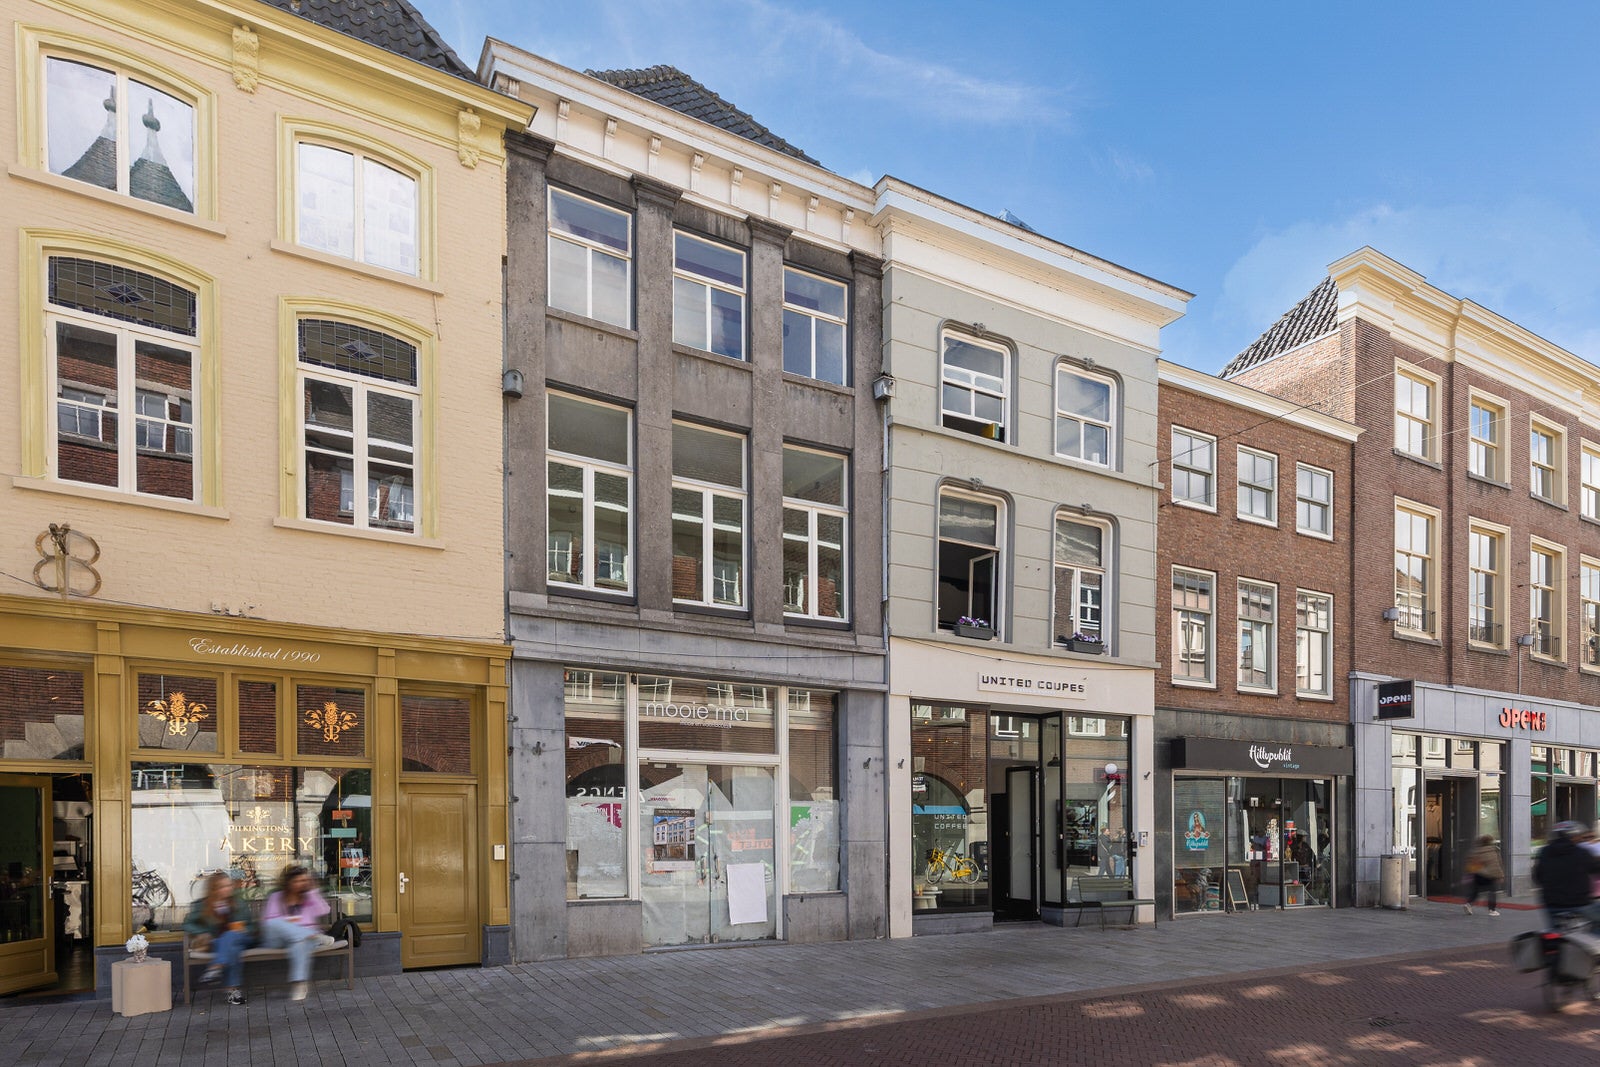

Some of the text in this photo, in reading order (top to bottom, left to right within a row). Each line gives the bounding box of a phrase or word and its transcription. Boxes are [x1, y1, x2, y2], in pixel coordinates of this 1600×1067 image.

[189, 637, 320, 662] Established 1990
[982, 675, 1032, 687] UNITED
[1037, 680, 1084, 692] COUPES
[646, 701, 708, 719] mooie
